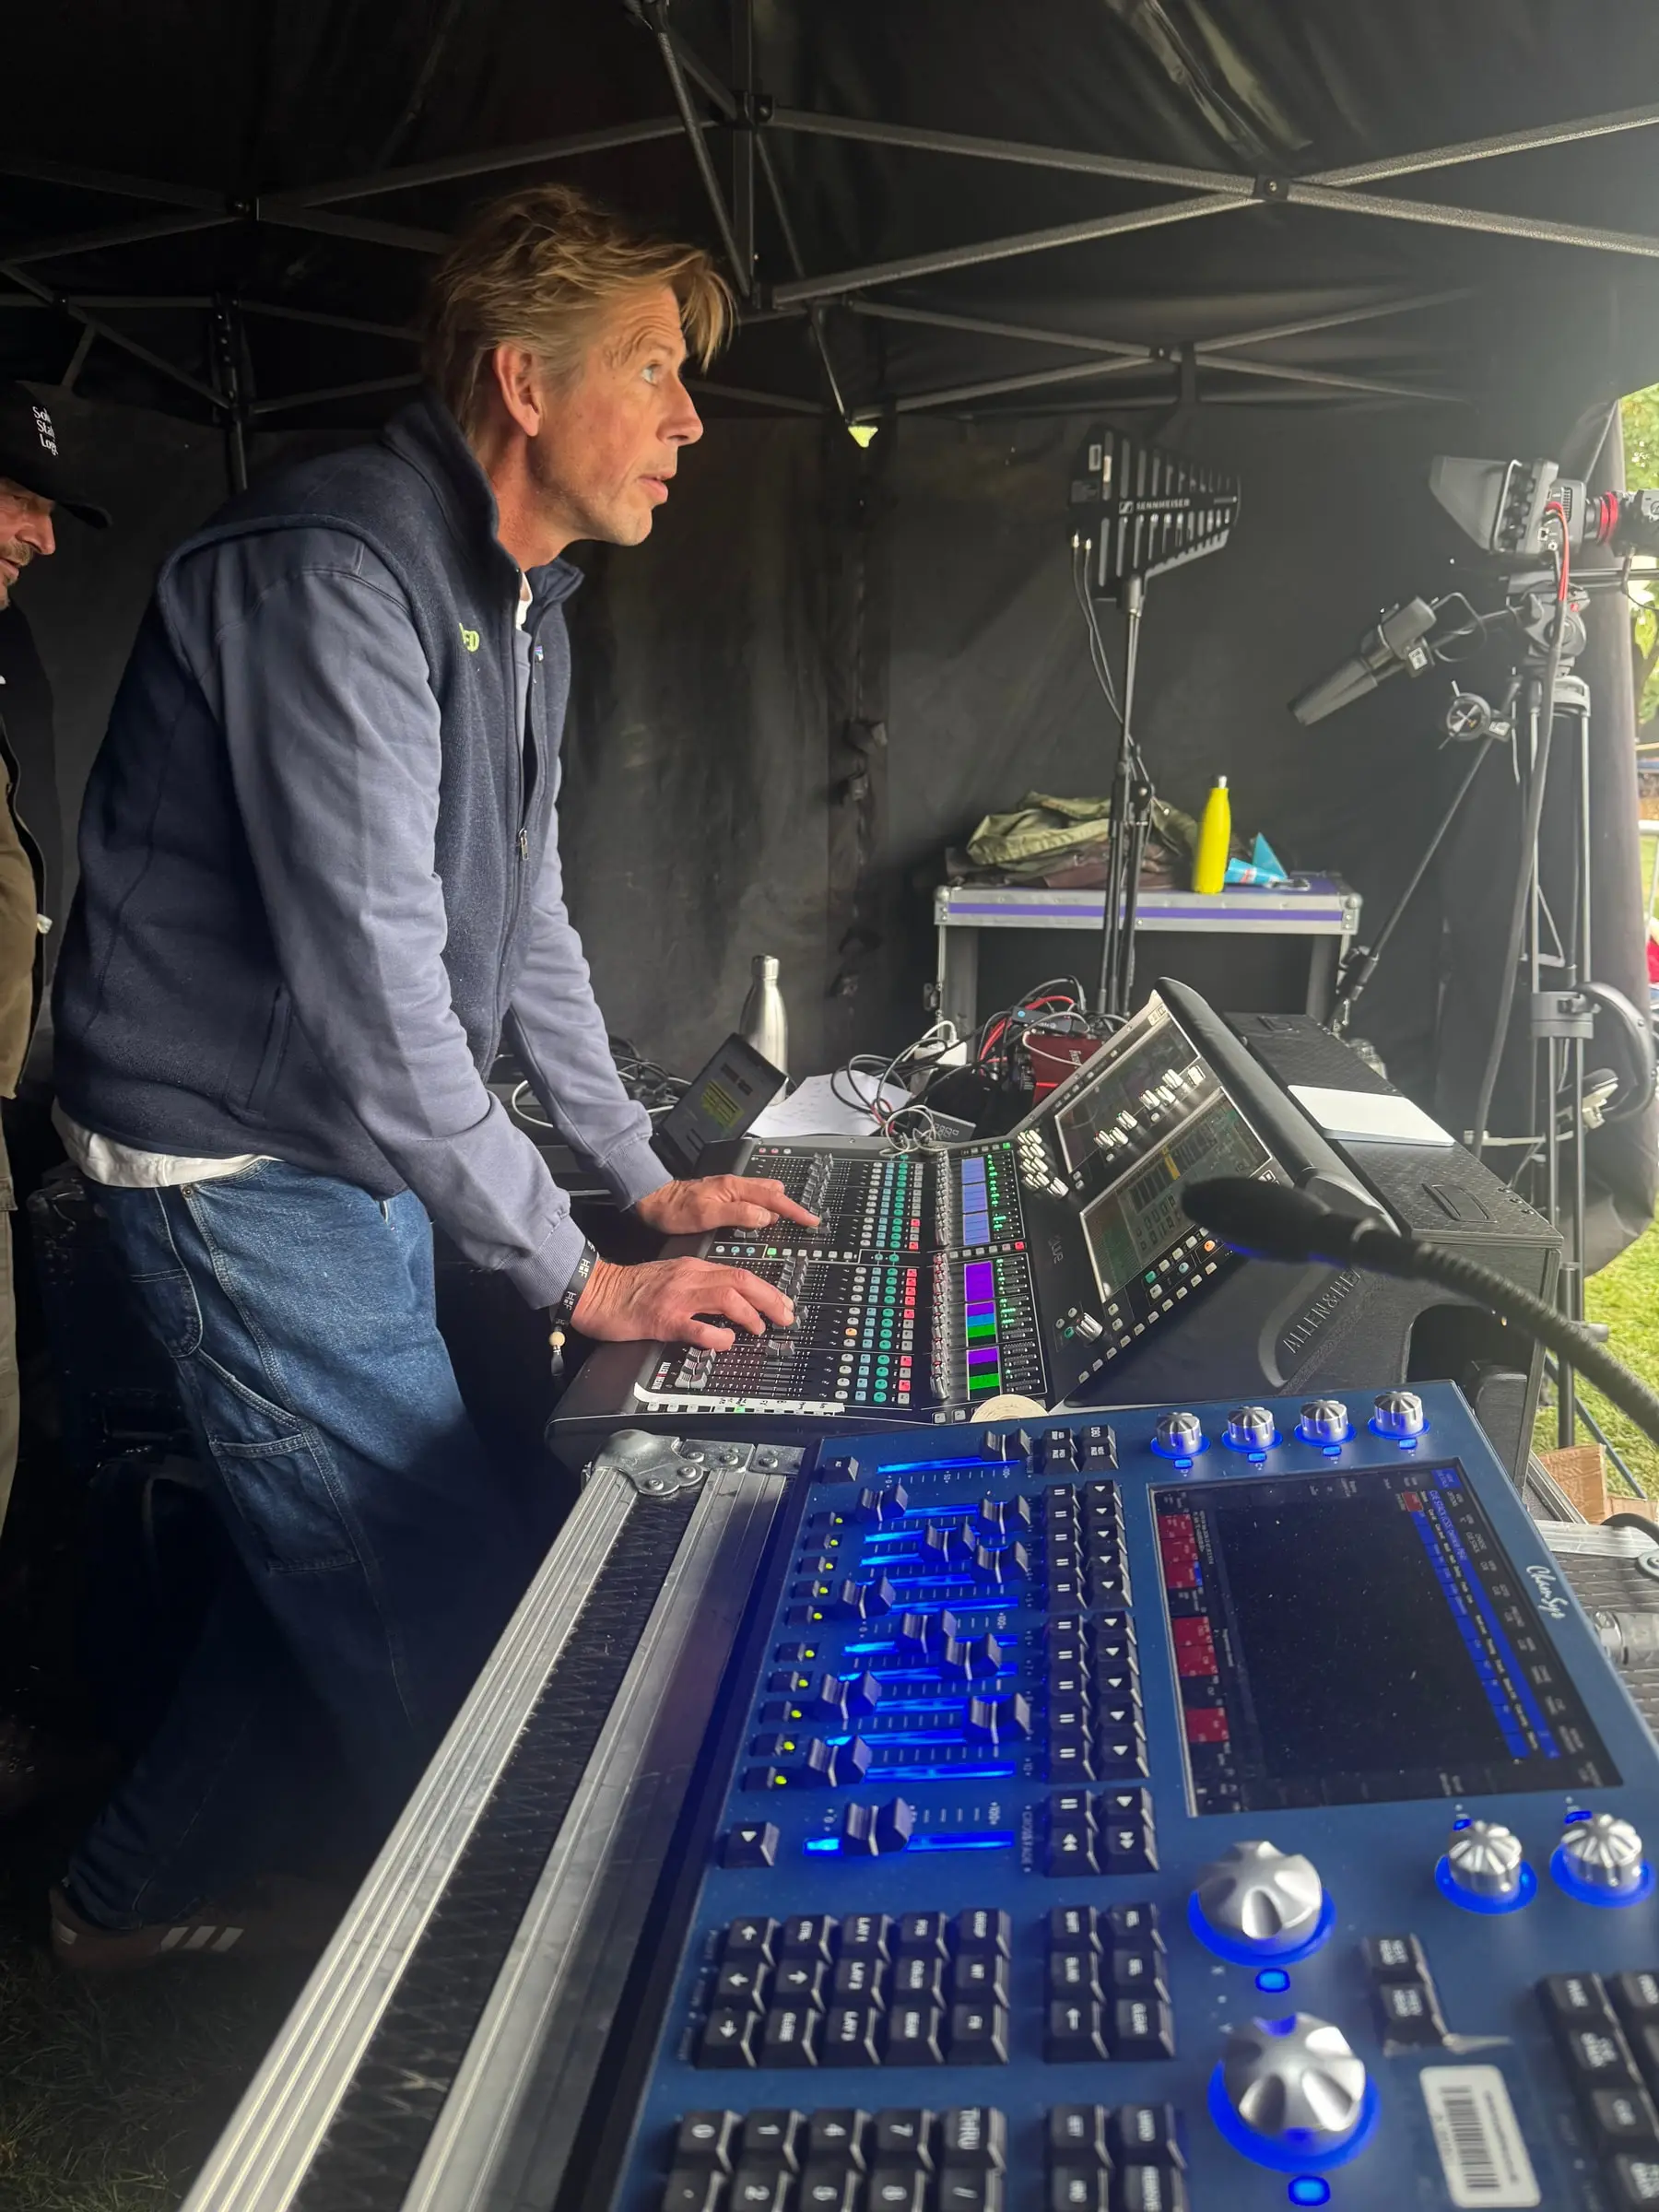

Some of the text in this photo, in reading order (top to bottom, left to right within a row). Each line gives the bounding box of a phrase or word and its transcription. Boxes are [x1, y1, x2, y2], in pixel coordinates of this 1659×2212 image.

[1135, 498, 1191, 510] SENNHEISER
[692, 2123, 715, 2138] 0
[758, 2123, 780, 2136] 1
[821, 2123, 846, 2137] 4
[890, 2123, 913, 2137] 7
[957, 2107, 981, 2149] THRU
[745, 2185, 770, 2201] 2
